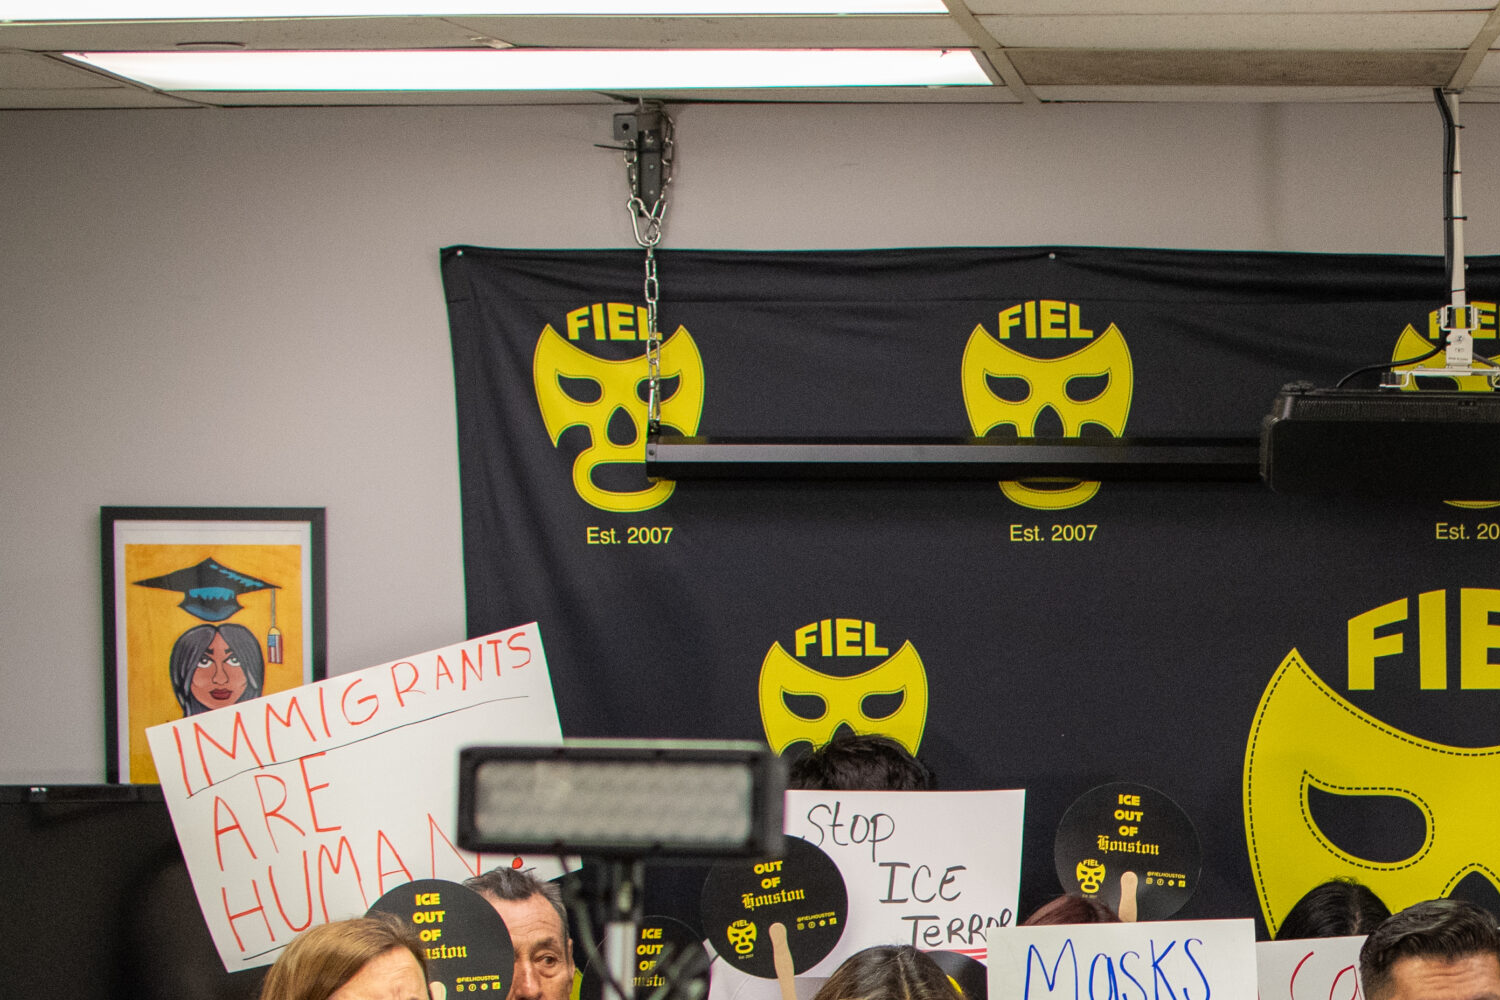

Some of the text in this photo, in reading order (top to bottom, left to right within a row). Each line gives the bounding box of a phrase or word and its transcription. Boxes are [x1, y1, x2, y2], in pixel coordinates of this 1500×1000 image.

[566, 302, 663, 340] FIEL
[998, 299, 1094, 339] FIEL
[586, 526, 673, 544] Est. 2007
[1009, 524, 1098, 542] Est. 2007
[1435, 522, 1470, 540] Est.
[795, 618, 889, 657] FIEL
[172, 632, 532, 798] IMMIGRANTS
[1118, 794, 1141, 806] ICE
[213, 751, 342, 871] ARE
[1113, 809, 1144, 822] OUT
[803, 801, 895, 863] Stop
[1118, 825, 1138, 837] OF
[1097, 835, 1160, 856] Houston
[753, 860, 783, 875] OUT
[1083, 859, 1100, 867] FIEL
[760, 876, 781, 889] OF
[878, 861, 967, 904] ICE
[415, 892, 441, 906] ICE
[741, 887, 805, 911] Houston
[412, 910, 445, 924] OUT
[732, 919, 749, 928] FIEL
[419, 928, 442, 942] OF
[641, 928, 663, 940] ICE
[426, 943, 468, 961] ston
[636, 944, 664, 956] OUT
